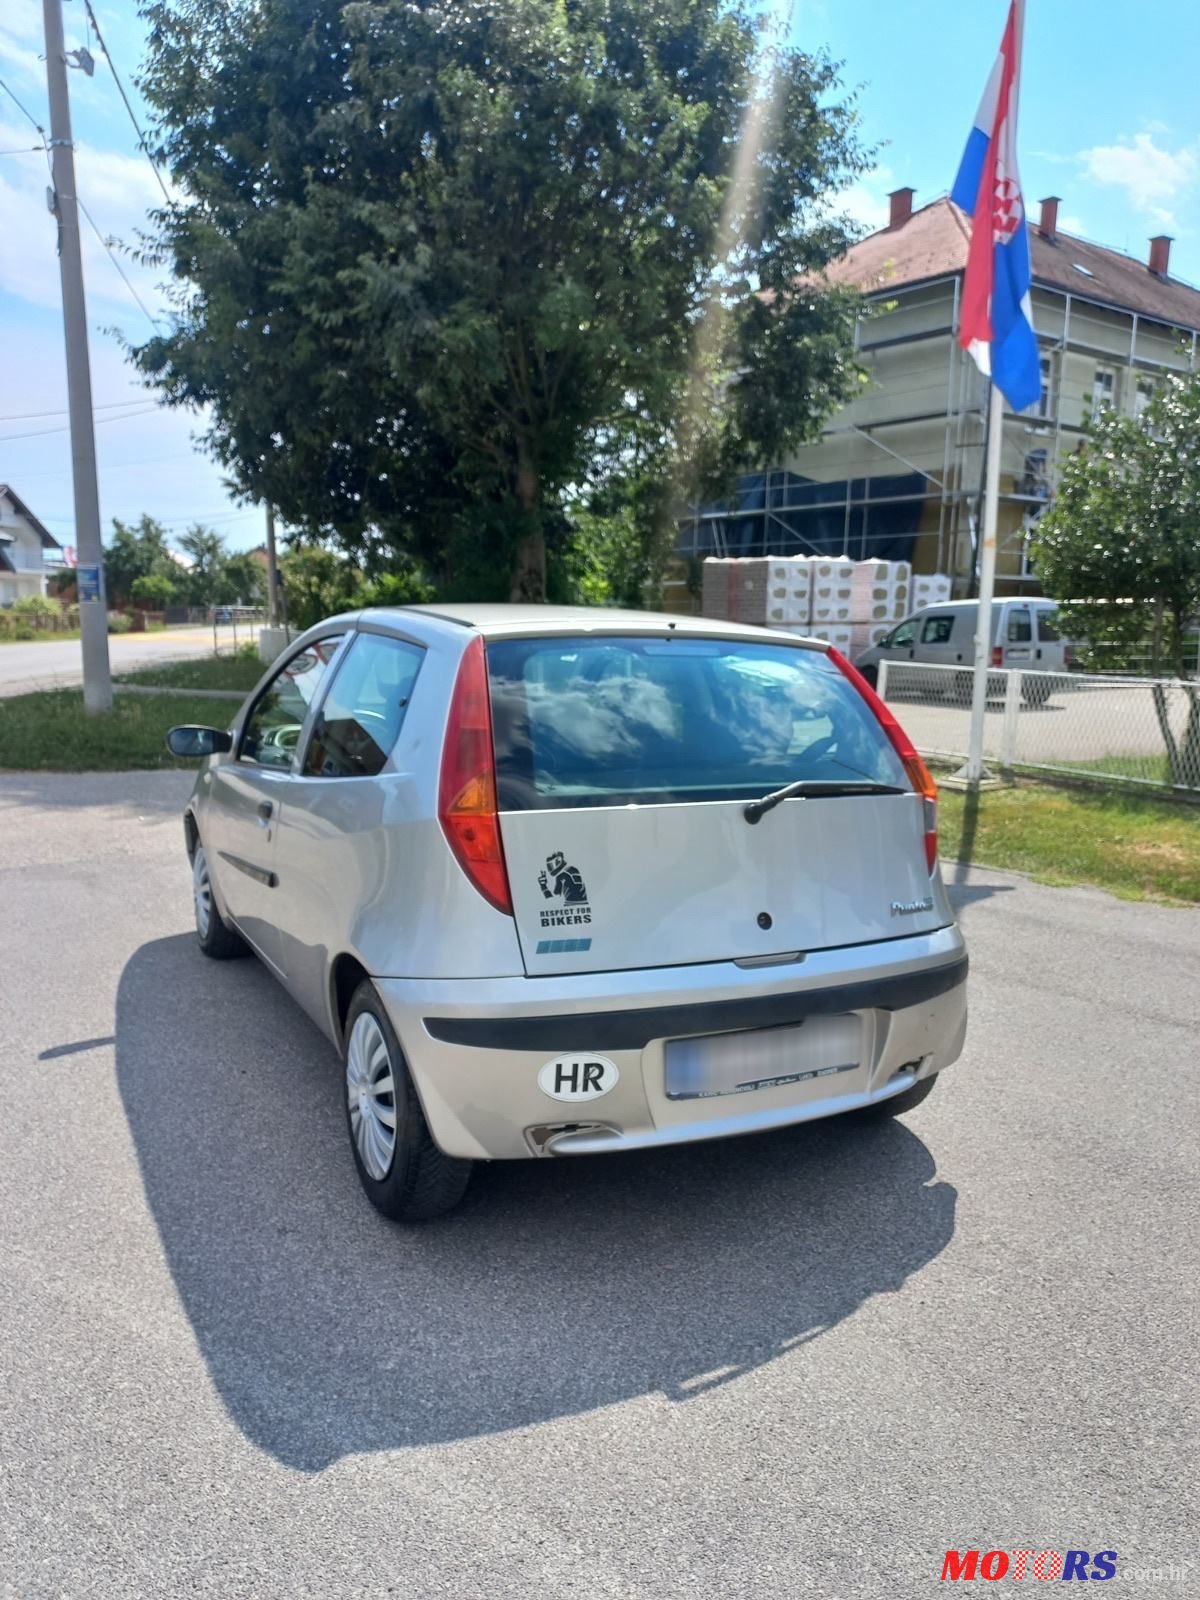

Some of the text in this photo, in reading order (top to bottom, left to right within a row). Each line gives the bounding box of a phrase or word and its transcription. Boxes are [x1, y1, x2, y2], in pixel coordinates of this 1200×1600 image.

[540, 908, 574, 917] RESPECT
[541, 914, 592, 927] BIKERS
[554, 1063, 605, 1093] HR
